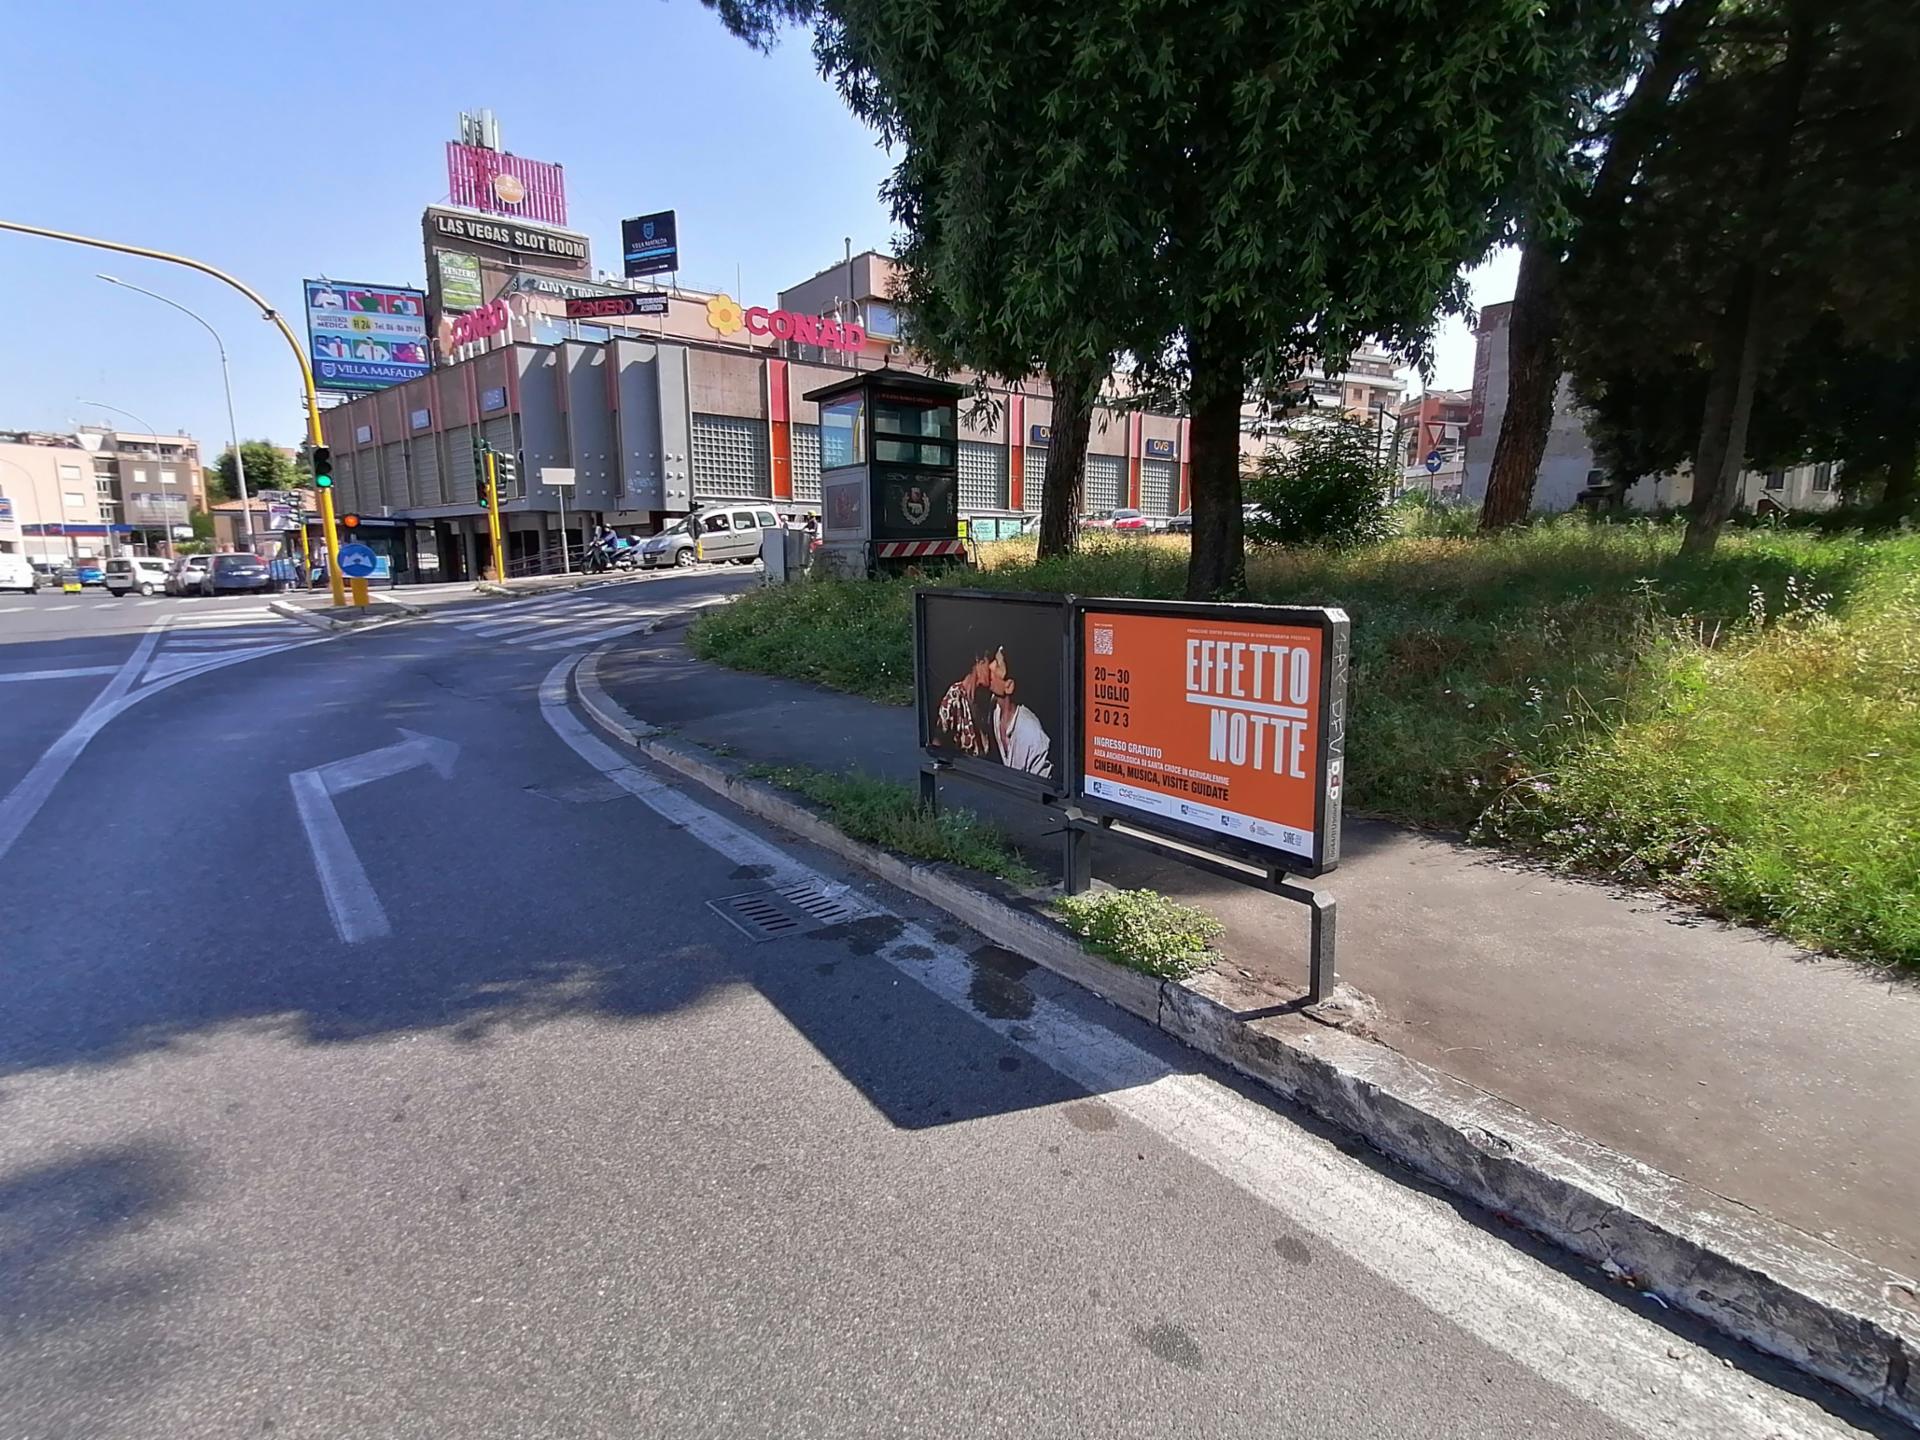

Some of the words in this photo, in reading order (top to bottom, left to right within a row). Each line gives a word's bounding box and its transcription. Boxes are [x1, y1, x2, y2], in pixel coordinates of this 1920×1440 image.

[438, 217, 464, 235] LAS
[466, 221, 510, 243] VEGAS
[514, 231, 546, 250] SLOT
[547, 237, 586, 258] ROOM
[443, 266, 477, 279] ZENZERO
[567, 299, 634, 318] ZENZERO
[745, 306, 866, 352] CONAD
[336, 364, 370, 375] VILLA
[370, 367, 424, 379] MAFALDA
[1039, 427, 1052, 439] OV
[1153, 439, 1169, 452] OVS
[1186, 638, 1311, 706] EFFETTO
[1094, 684, 1130, 704] LUGLIO
[1094, 707, 1130, 729] 2023
[1094, 736, 1127, 752] INGRESSO
[1128, 742, 1162, 759] GRATUITO
[1209, 707, 1309, 780] NOTTE
[1147, 759, 1165, 771] SANTA
[1165, 764, 1182, 775] CROCE
[1093, 758, 1126, 778] CINEMA,
[1126, 766, 1162, 787] MUSICA,
[1162, 774, 1189, 792] VISITE
[1191, 780, 1230, 802] GUIDATE
